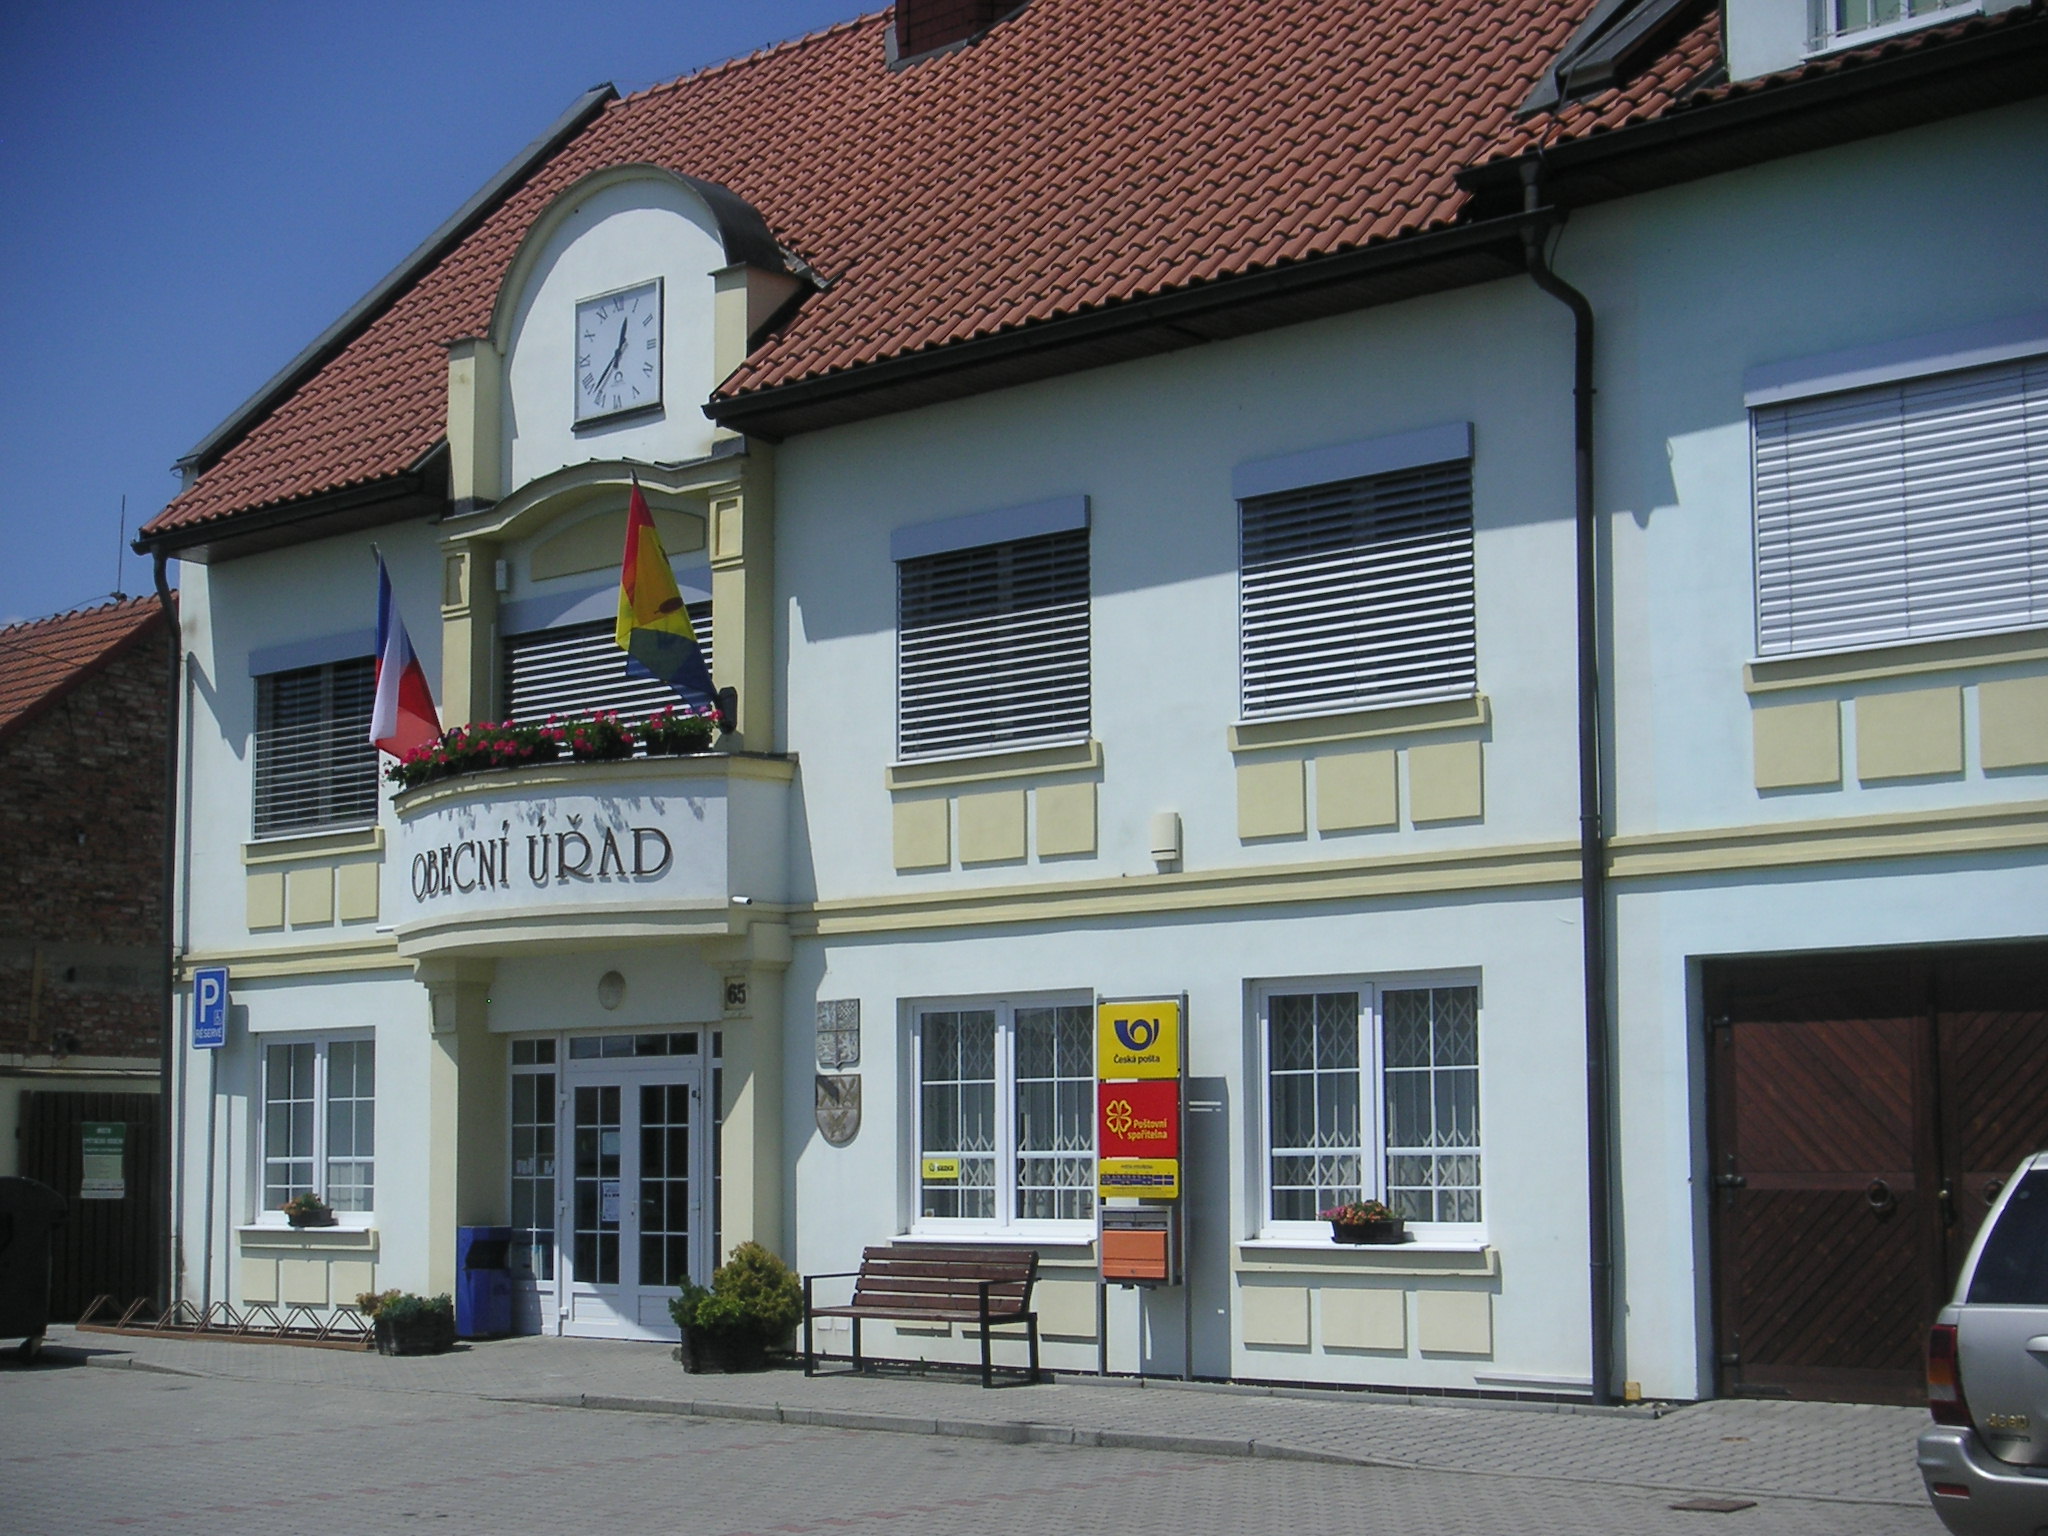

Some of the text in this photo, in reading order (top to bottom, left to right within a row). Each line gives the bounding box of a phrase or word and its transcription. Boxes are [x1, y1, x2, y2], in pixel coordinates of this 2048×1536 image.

[643, 313, 654, 327] II
[584, 329, 596, 343] X
[646, 338, 657, 350] III
[579, 354, 591, 369] IX
[632, 385, 640, 399] V
[411, 813, 673, 899] OBECNÍ ÚŘAD
[200, 978, 220, 1023] P
[727, 982, 747, 1005] 65
[1113, 1054, 1160, 1065] Česká pošta
[1133, 1118, 1168, 1129] Poštovní
[1127, 1129, 1168, 1142] spořitelna
